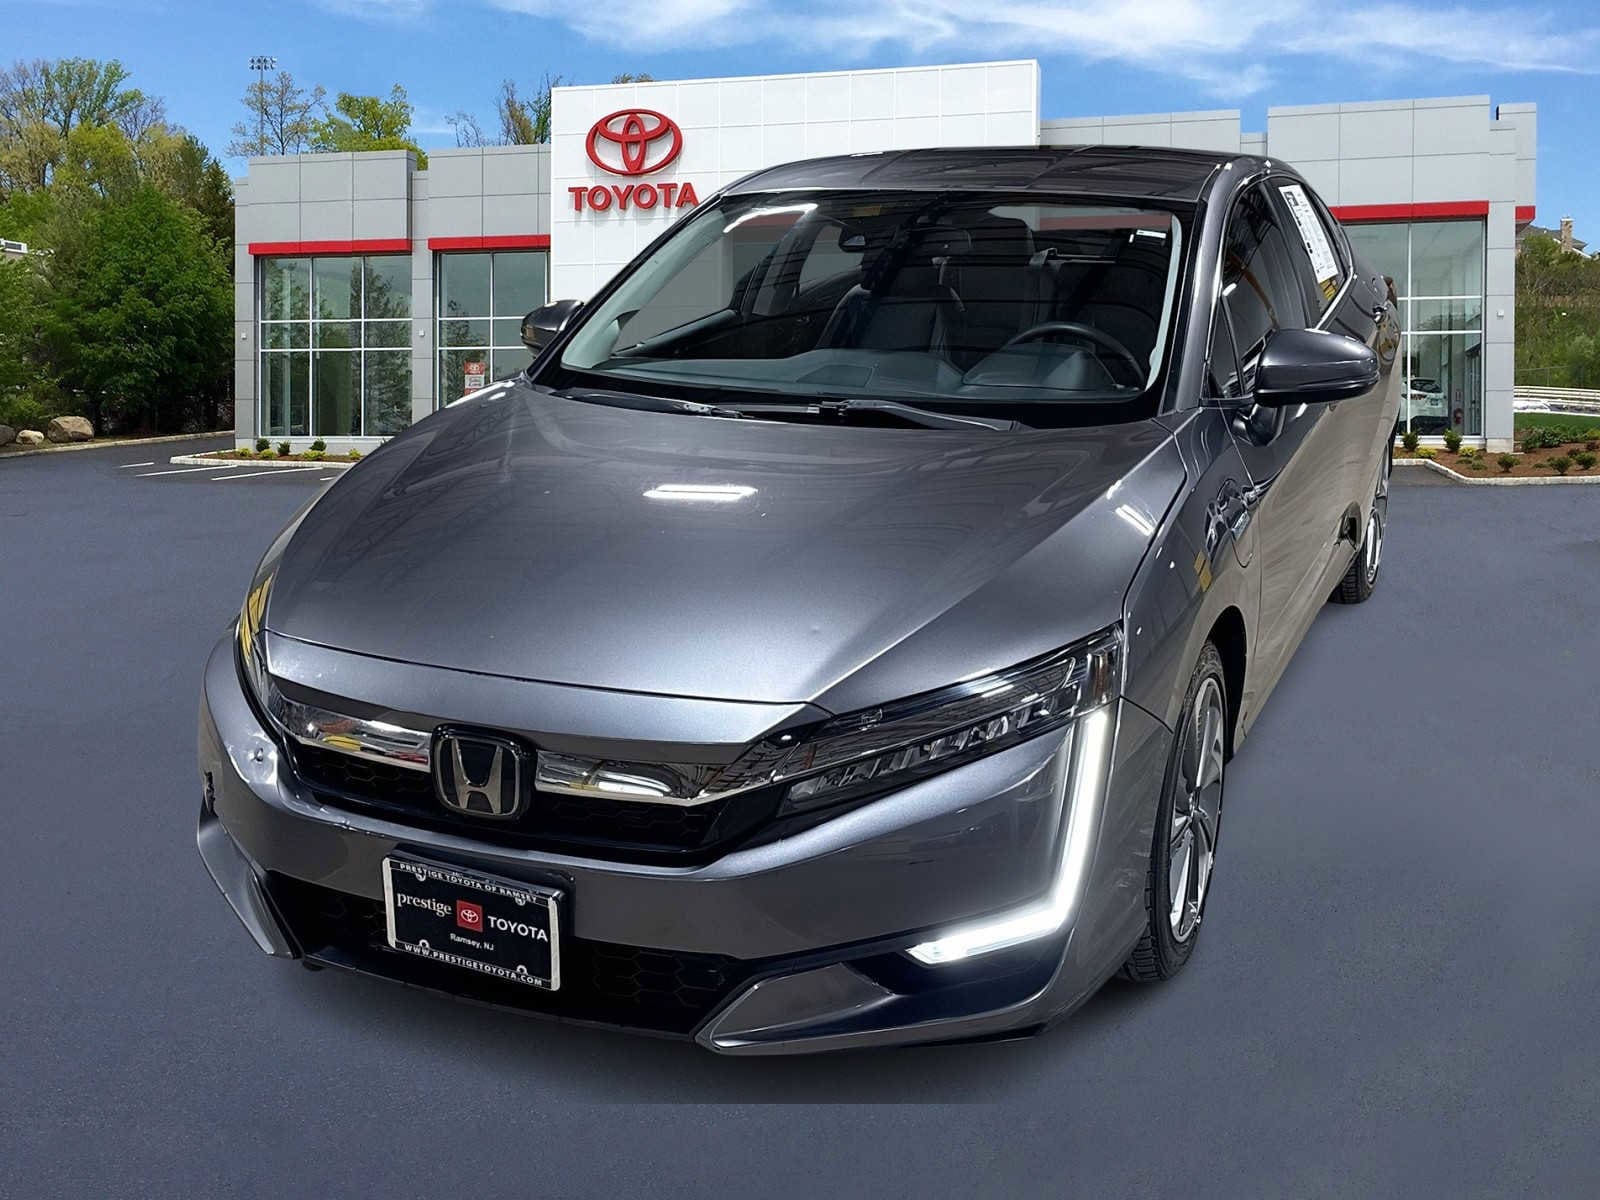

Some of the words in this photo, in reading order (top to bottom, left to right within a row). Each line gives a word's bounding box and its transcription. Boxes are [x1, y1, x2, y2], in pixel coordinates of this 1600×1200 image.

[568, 182, 700, 211] TOYOTA
[400, 863, 444, 880] PRESTIGE
[446, 873, 482, 889] TOYOTA
[484, 881, 497, 893] OF
[500, 887, 537, 903] RAMSEY
[396, 892, 452, 917] prestige
[488, 915, 548, 942] TOYOTA
[405, 944, 542, 986] WWW.PRESTIGETOYOTA.COM
[484, 940, 494, 951] NJ
